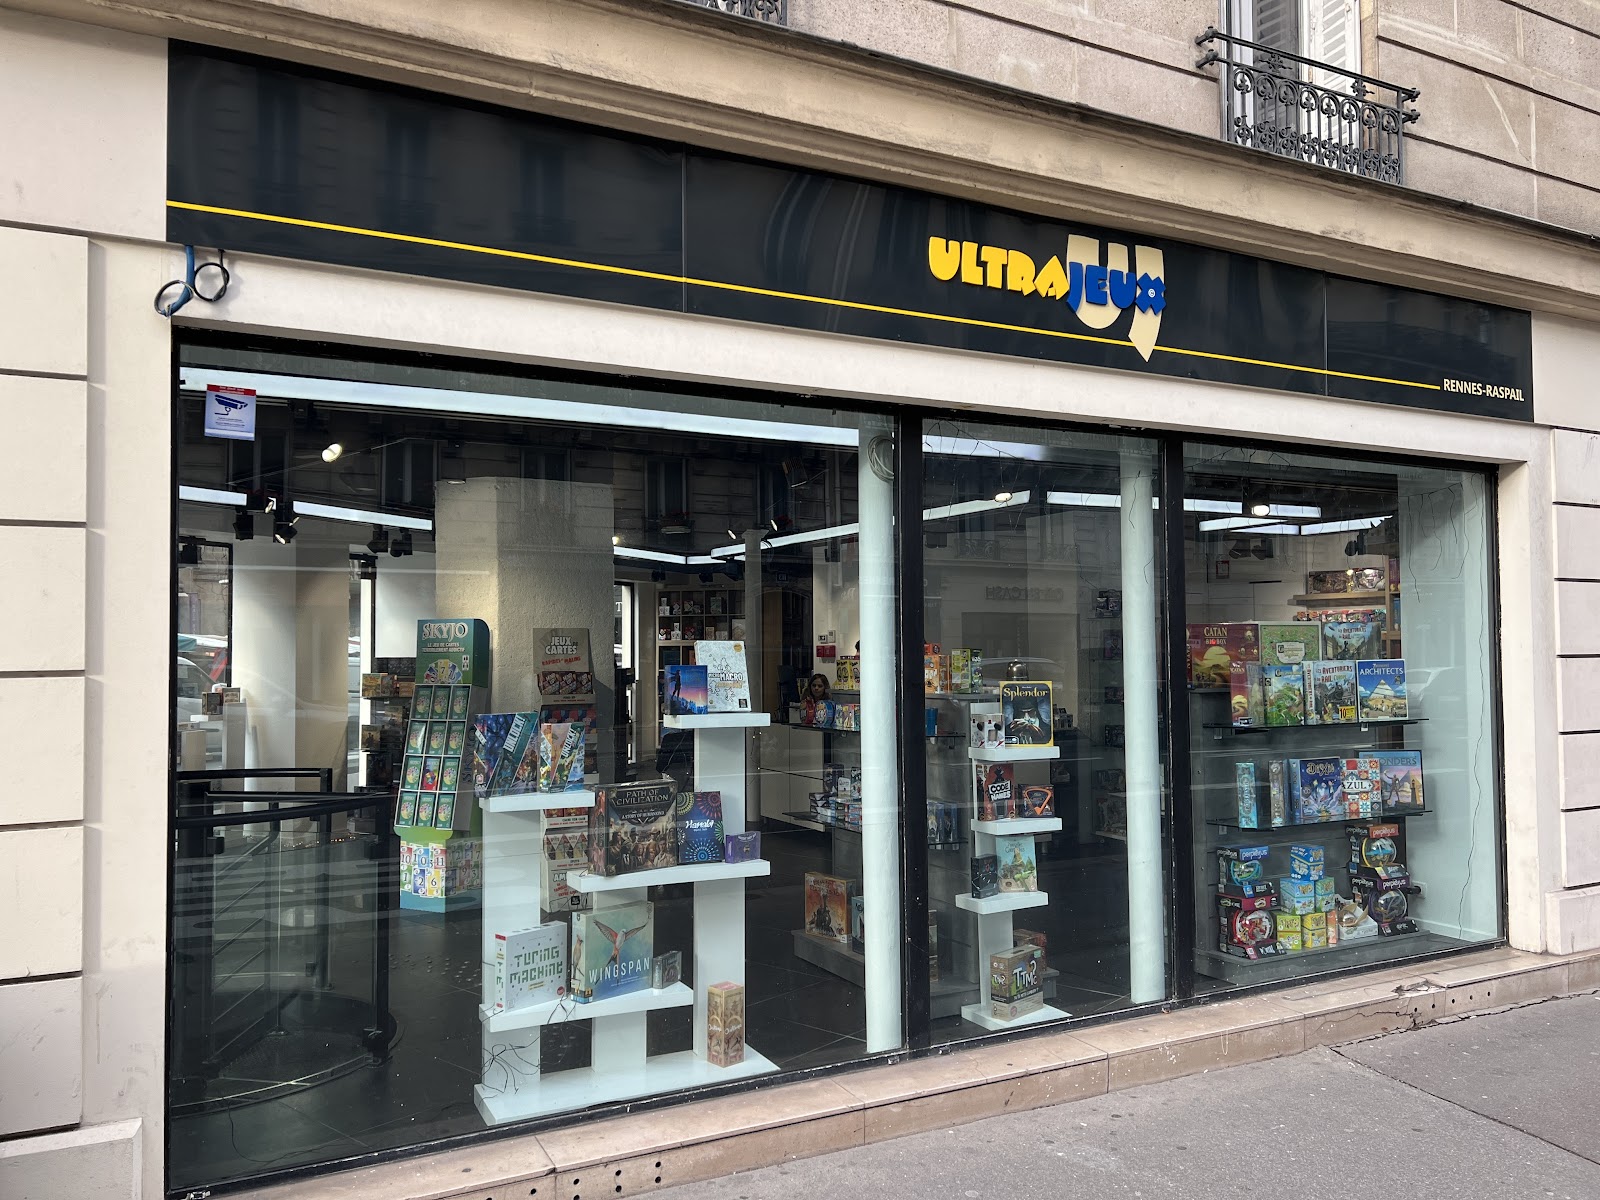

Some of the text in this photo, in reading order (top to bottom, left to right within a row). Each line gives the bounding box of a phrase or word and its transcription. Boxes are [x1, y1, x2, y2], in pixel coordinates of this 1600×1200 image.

[1443, 378, 1525, 402] RENNES-RASPAIL
[422, 622, 469, 642] SKYJO
[1203, 626, 1228, 637] CATAN
[551, 636, 572, 646] JEUX
[545, 645, 577, 655] CARTES
[720, 671, 744, 682] MACRO
[1359, 667, 1404, 676] ARCHITECTS
[1321, 675, 1332, 683] RAIL
[1003, 685, 1048, 702] Splendor
[1339, 707, 1347, 720] 10
[503, 714, 527, 754] UNLOCK!
[561, 728, 577, 758] UNLOCK!
[989, 781, 1010, 794] CODE
[1342, 780, 1367, 790] AZUL
[616, 793, 669, 805] CIVILIZATION
[626, 788, 659, 799] PATH OF
[401, 854, 411, 864] 10
[420, 857, 427, 865] 0
[436, 857, 444, 866] 11
[430, 877, 437, 886] 6
[588, 956, 651, 984] WINGSPAN
